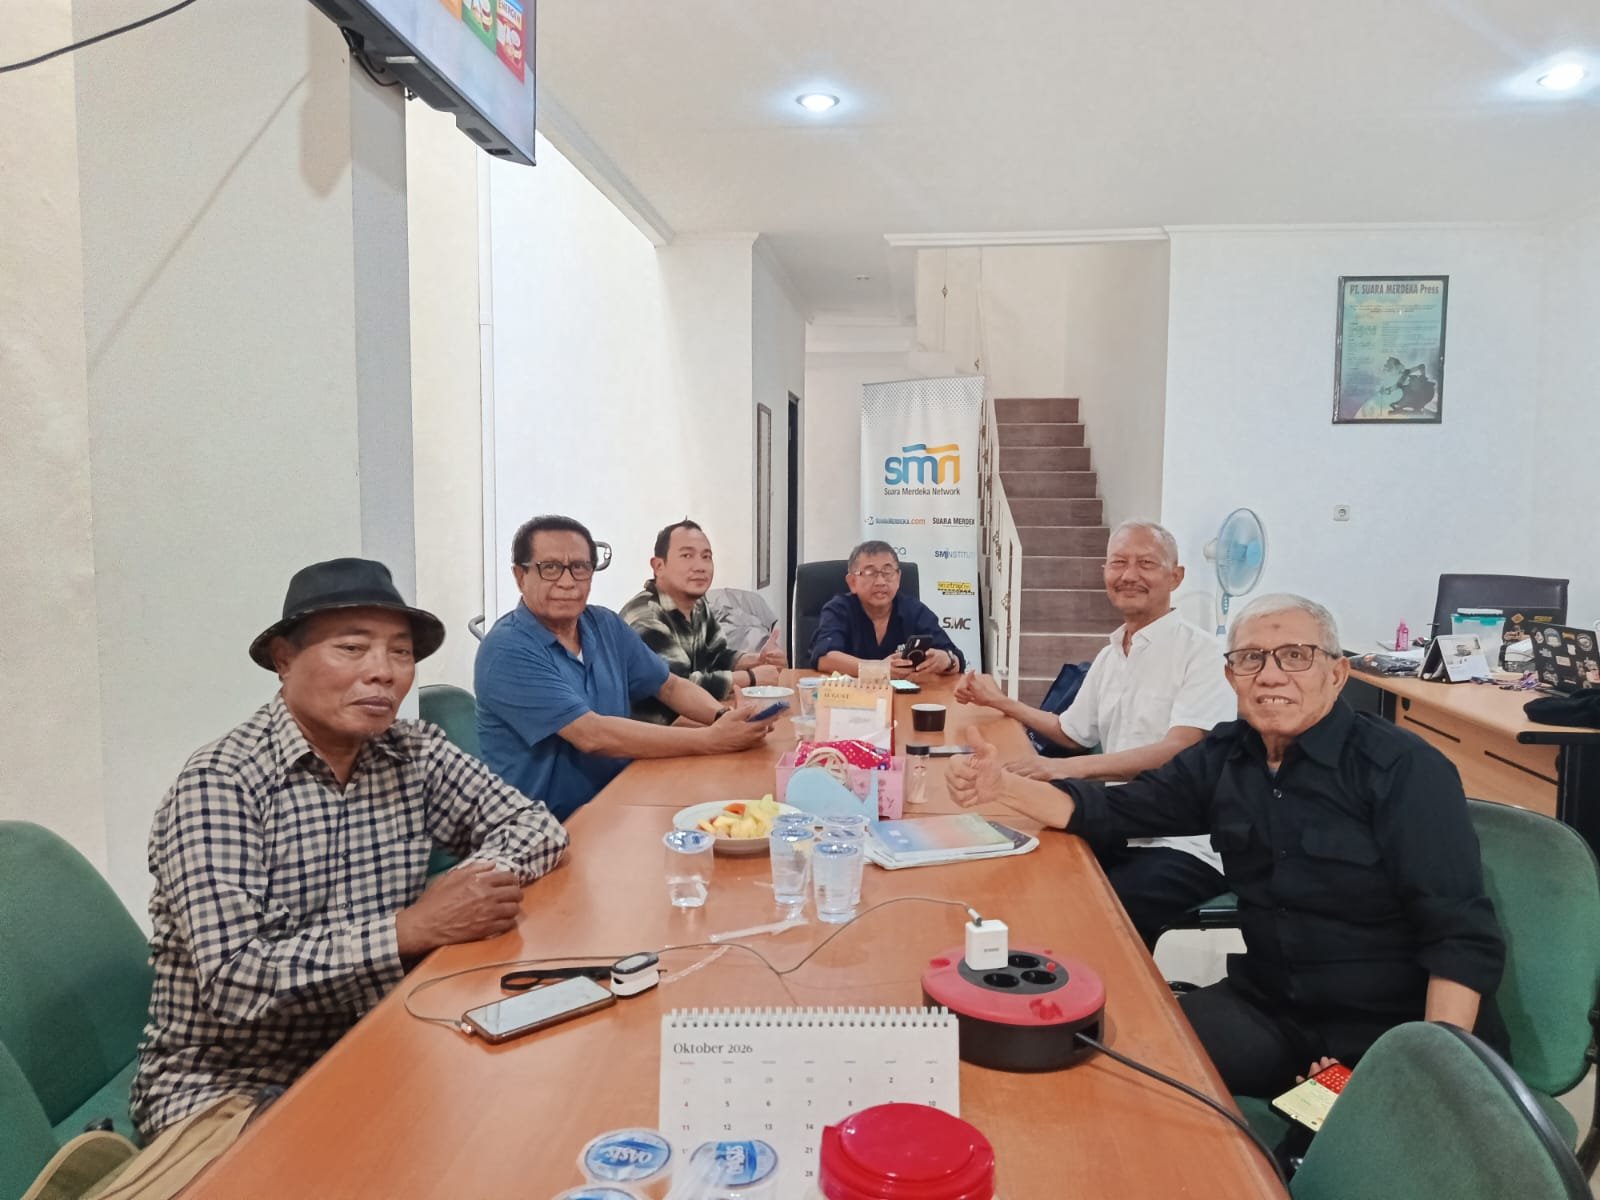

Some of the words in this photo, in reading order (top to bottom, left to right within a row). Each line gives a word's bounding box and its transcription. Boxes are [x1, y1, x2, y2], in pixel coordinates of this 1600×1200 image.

[1361, 284, 1383, 294] SUARA
[1386, 284, 1418, 294] MERDEKA
[1420, 284, 1440, 294] Press
[884, 444, 960, 486] smn
[884, 488, 900, 496] Suara
[902, 488, 930, 496] Merdeka
[932, 488, 960, 496] Network
[933, 517, 951, 525] SUARA
[673, 1042, 724, 1055] Oktober
[727, 1044, 753, 1054] 2026
[724, 1123, 731, 1131] 12
[765, 1123, 773, 1131] 13
